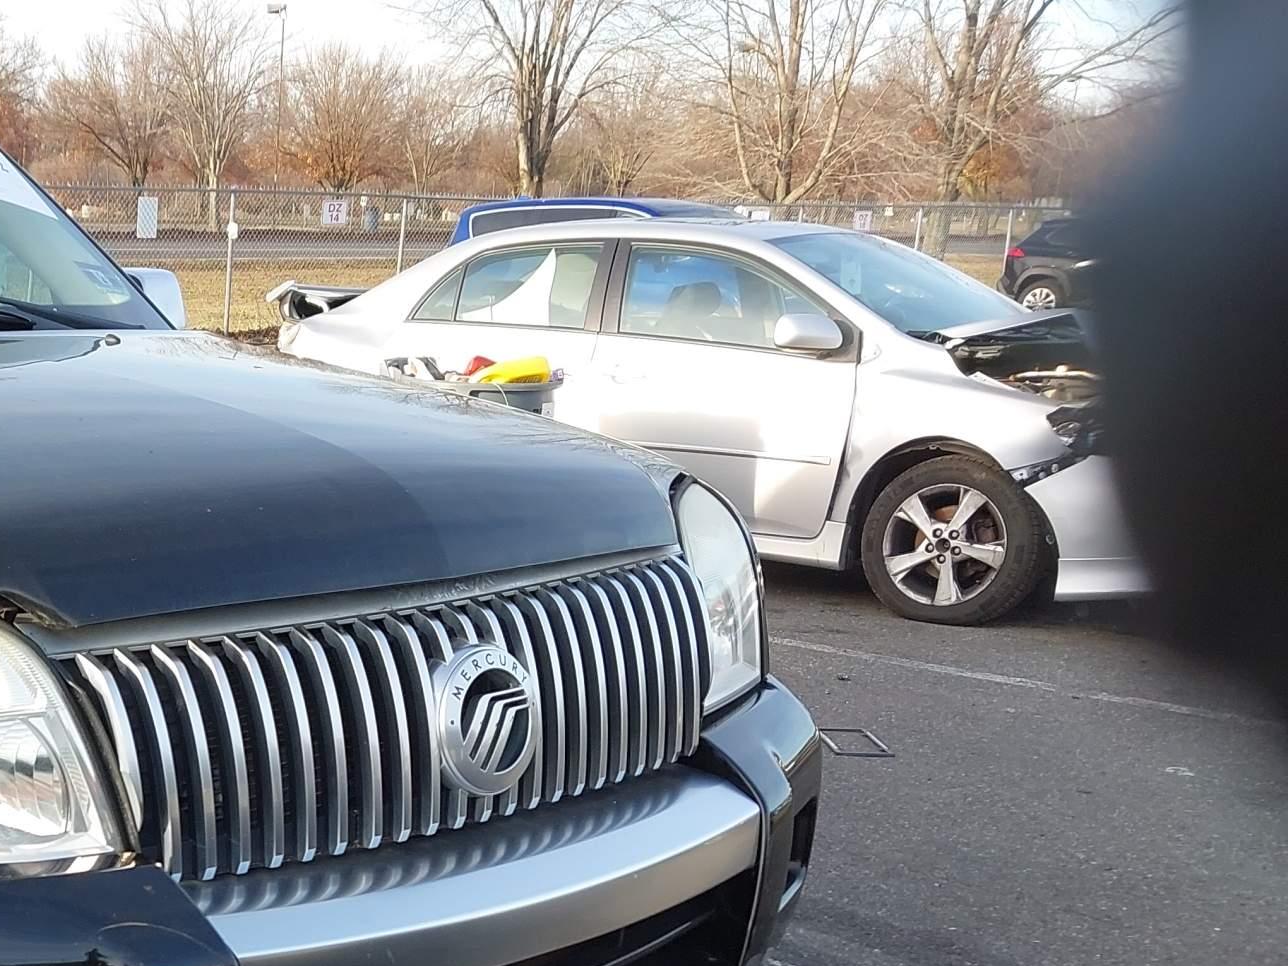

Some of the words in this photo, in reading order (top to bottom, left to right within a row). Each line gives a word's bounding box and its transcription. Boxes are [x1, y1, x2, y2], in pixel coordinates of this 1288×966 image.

[328, 203, 343, 213] DZ
[329, 213, 340, 222] 14
[452, 653, 530, 700] MERCURY
